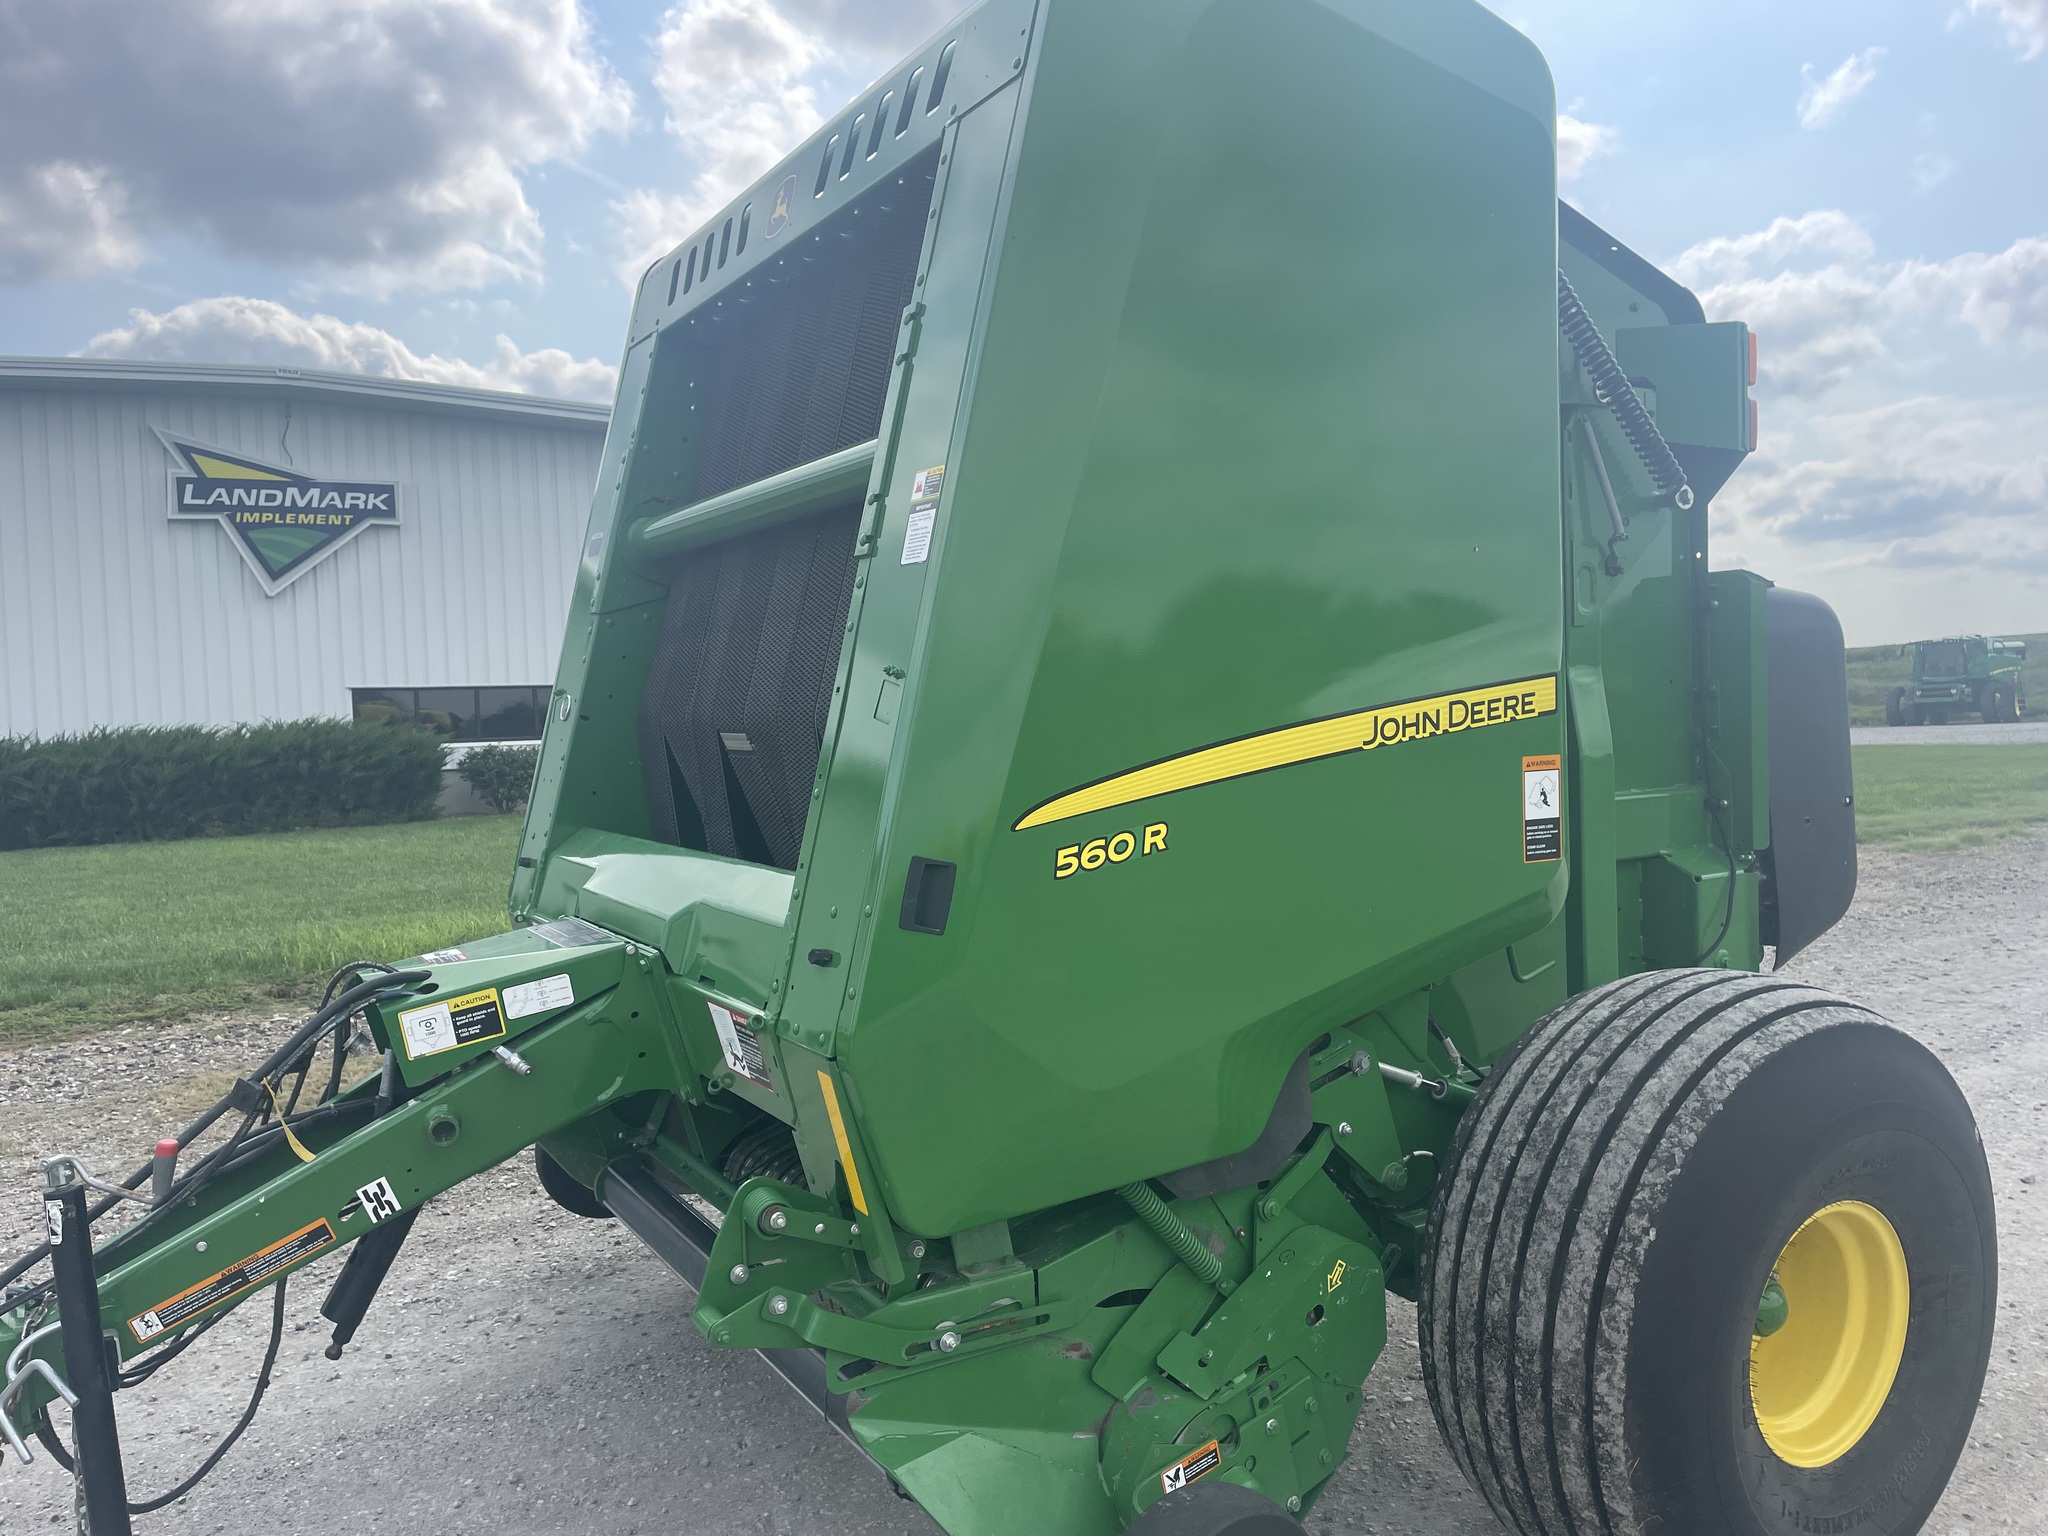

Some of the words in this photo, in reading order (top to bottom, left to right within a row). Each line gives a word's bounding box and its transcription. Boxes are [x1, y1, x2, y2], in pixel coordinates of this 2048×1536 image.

[235, 512, 354, 525] IMPLEMENT
[1362, 708, 1441, 746] JOHN
[1449, 692, 1536, 729] DEERE
[1531, 759, 1556, 768] WARNING
[1054, 829, 1137, 880] 560
[1141, 821, 1169, 857] R
[460, 994, 491, 1007] CAUTION
[225, 1252, 260, 1275] WARNING
